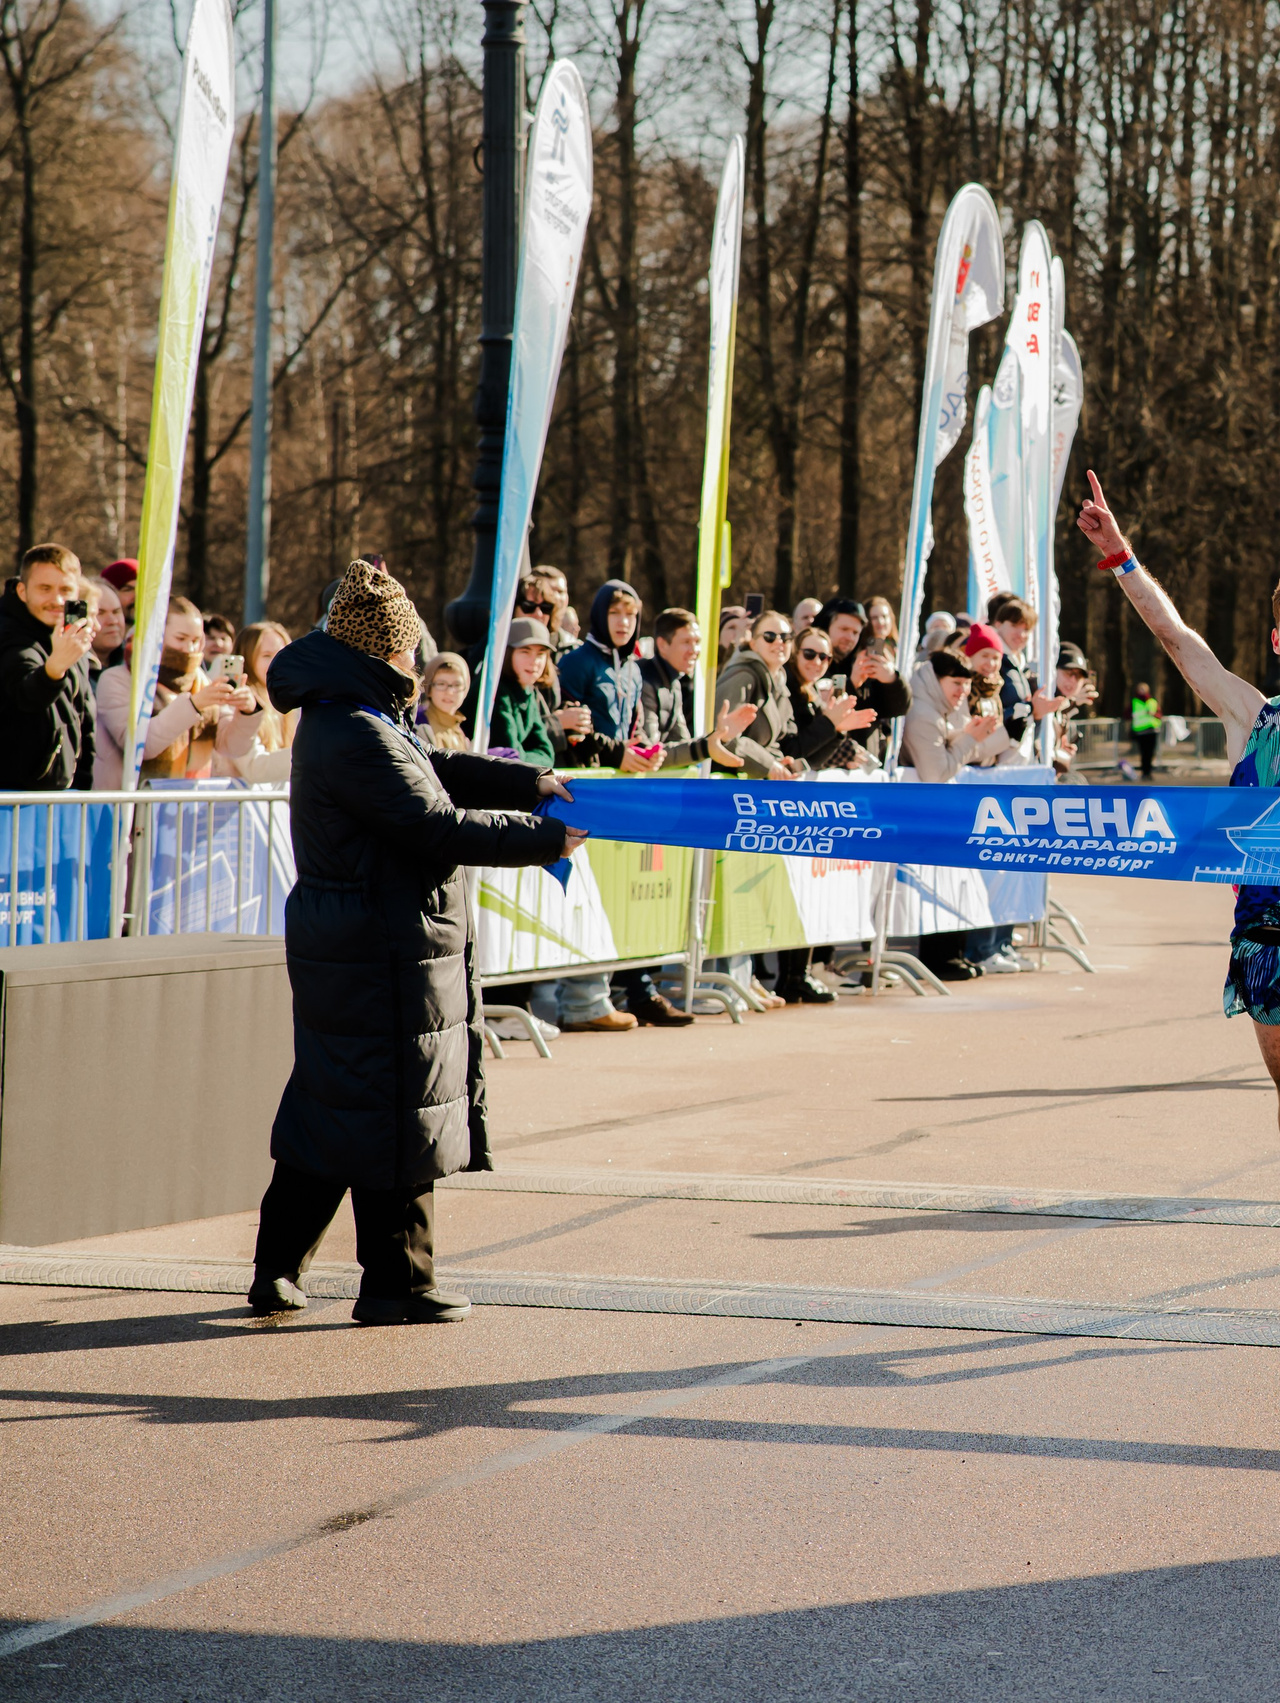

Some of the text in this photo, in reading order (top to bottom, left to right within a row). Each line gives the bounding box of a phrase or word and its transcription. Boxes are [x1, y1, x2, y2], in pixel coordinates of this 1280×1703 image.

[733, 793, 858, 818] В темпе
[734, 818, 882, 838] Великого
[971, 796, 1176, 838] АРЕНА
[725, 833, 834, 854] города
[966, 836, 1177, 854] ПОЛУМАРАФОН
[978, 848, 1154, 871] Санкт-Петербург
